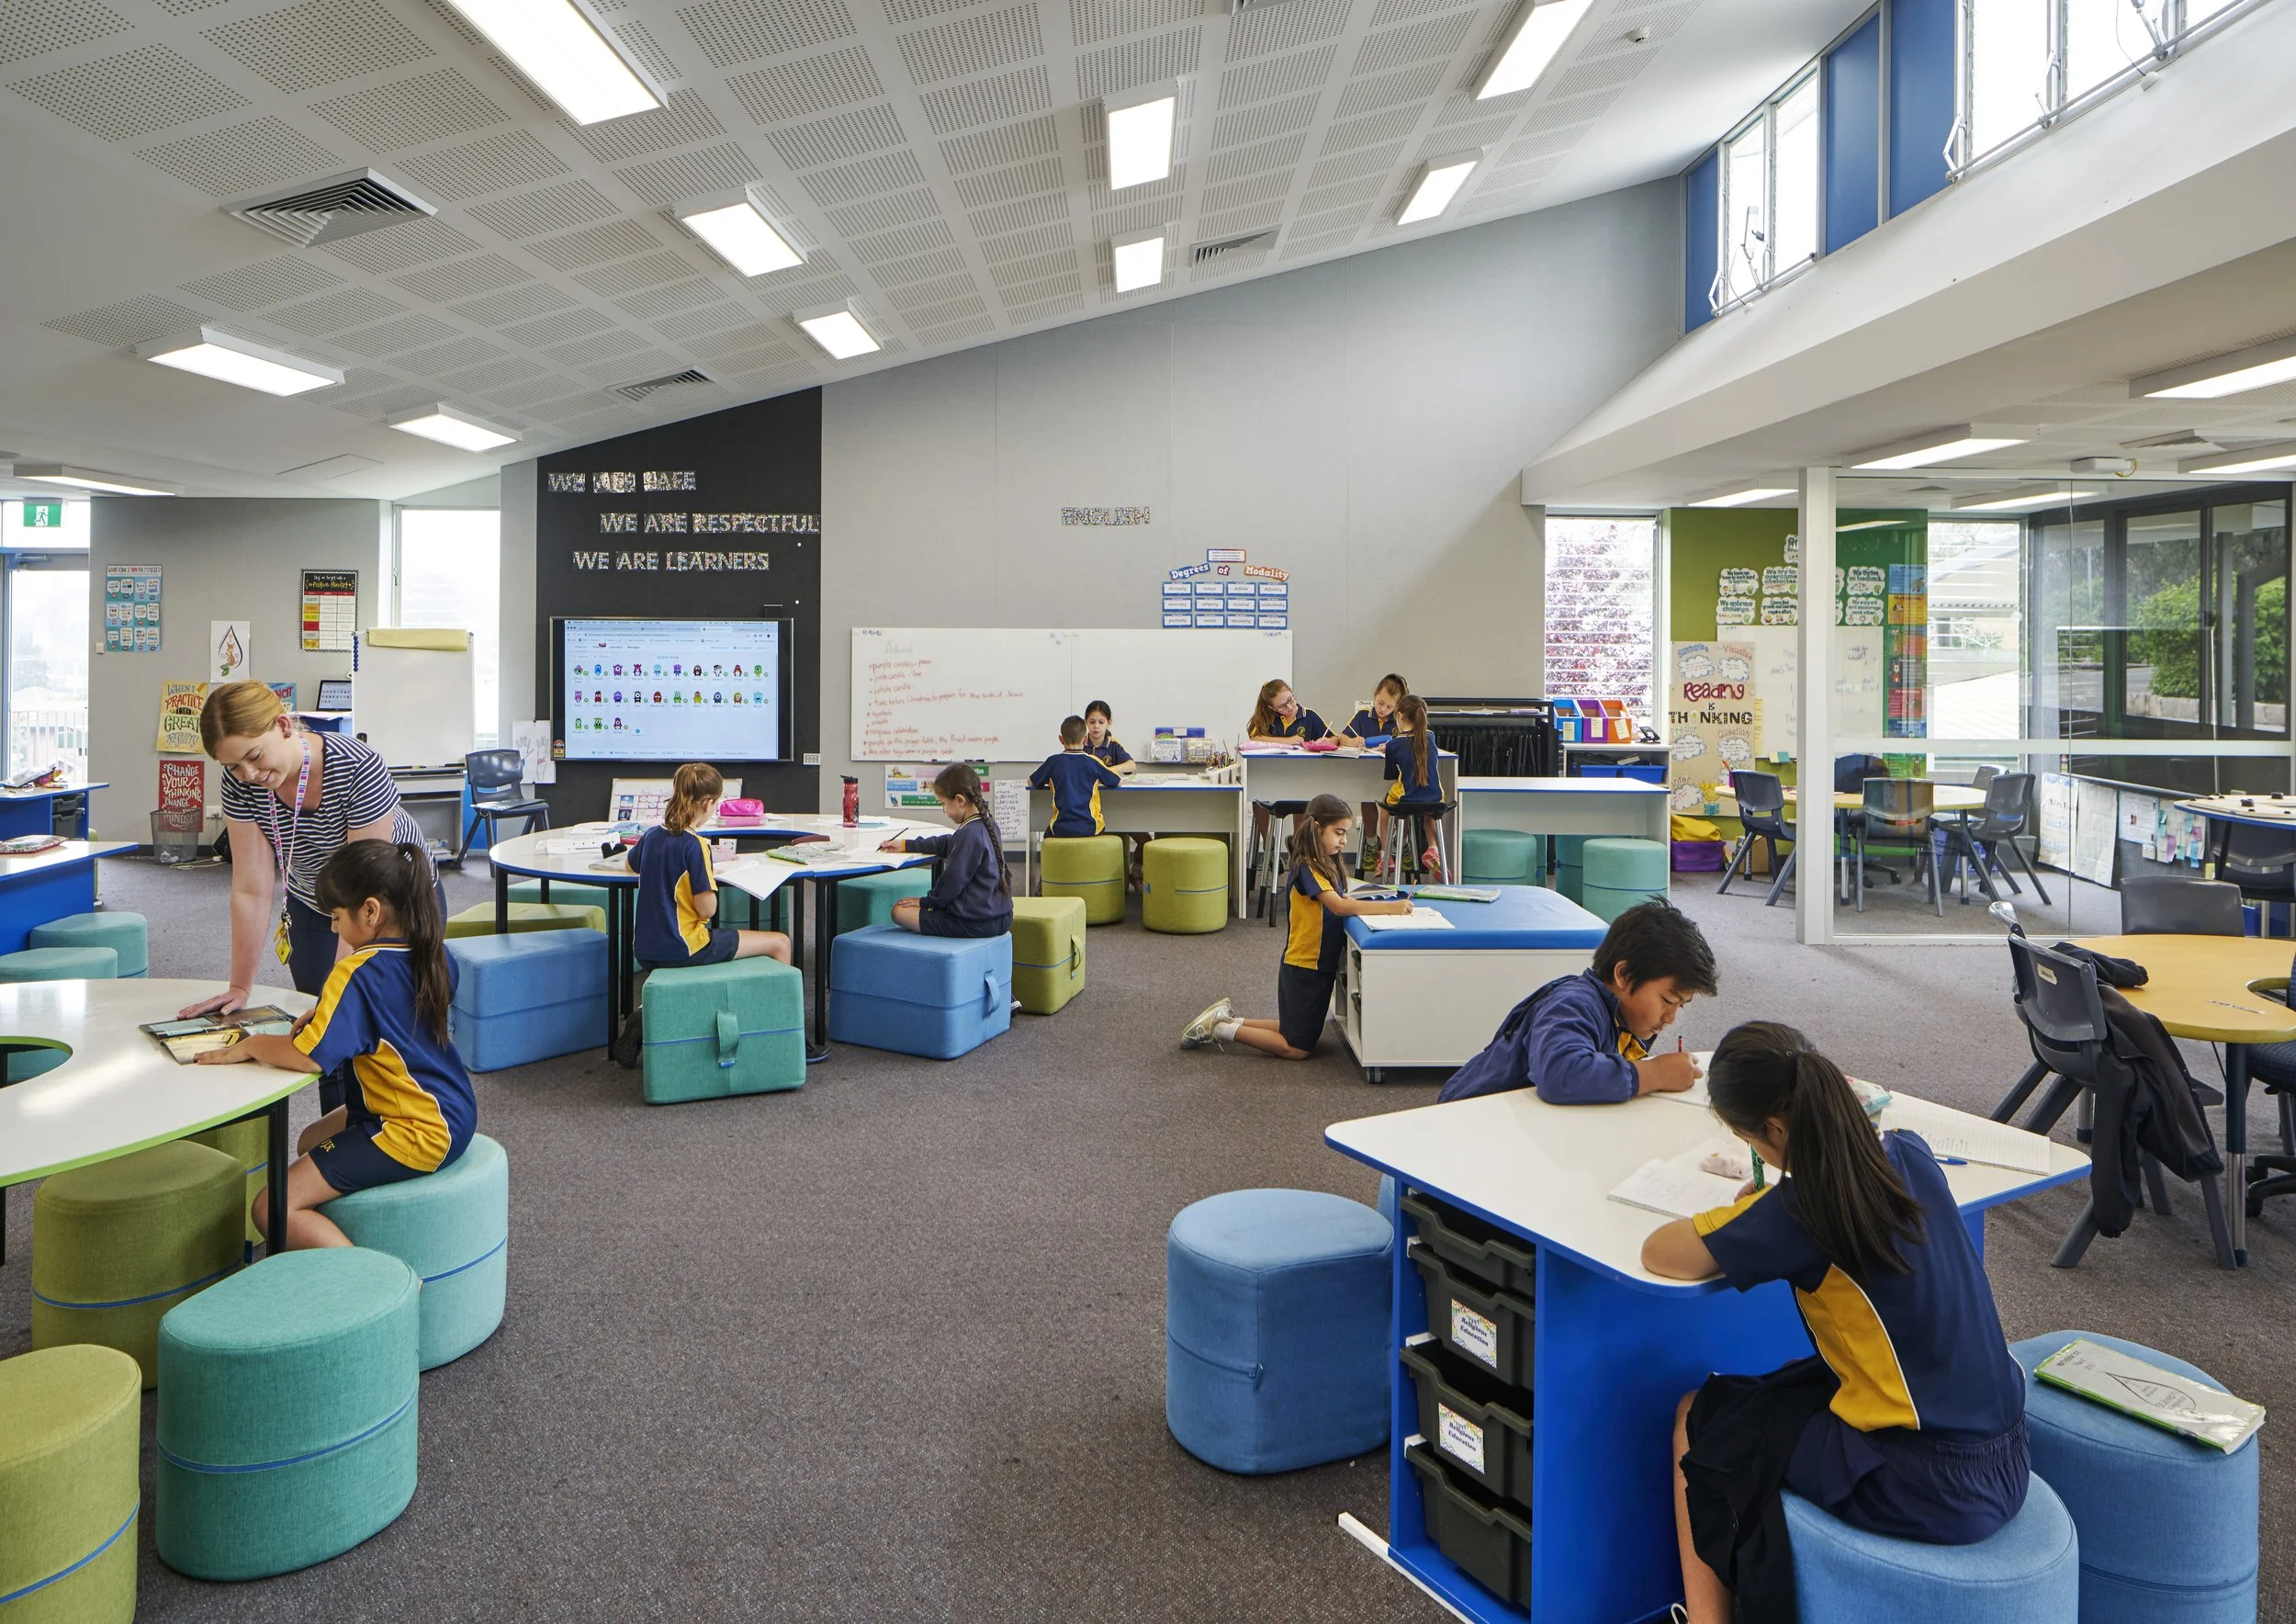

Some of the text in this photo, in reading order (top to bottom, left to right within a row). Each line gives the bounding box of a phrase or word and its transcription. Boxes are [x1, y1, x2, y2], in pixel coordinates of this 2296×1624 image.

[601, 513, 820, 534] WE ARE RESPECTFUL
[1061, 507, 1150, 525] ENGLISH
[574, 552, 770, 571] WE ARE LEARNERS
[1171, 564, 1289, 581] Degrees of Modality
[167, 684, 190, 695] WHEN
[1683, 682, 1744, 702] Reading
[165, 694, 203, 710] PRACTICE
[164, 716, 199, 733] GREAT
[1669, 711, 1752, 724] THNKING
[163, 763, 199, 777] CHANGE
[163, 773, 199, 795] YOUR
[1460, 1325, 1489, 1347] Education
[1461, 1317, 1488, 1336] Religious
[1448, 1430, 1477, 1451] Education
[1449, 1422, 1475, 1442] Religious
